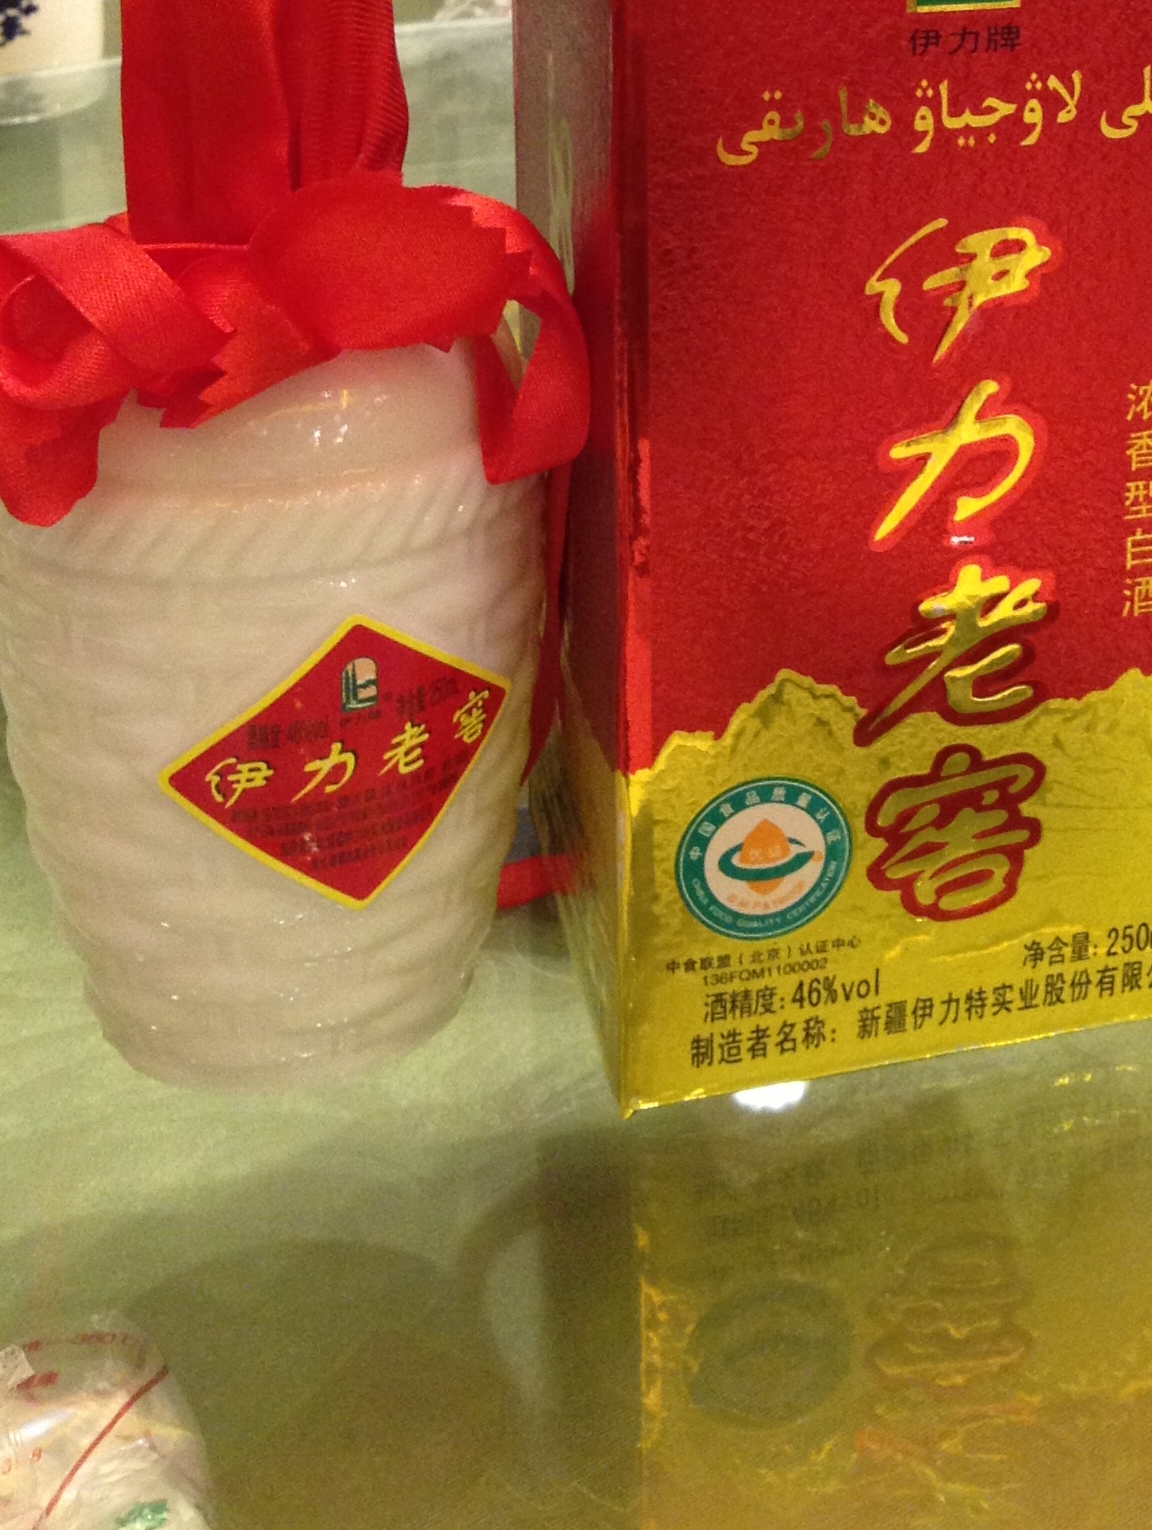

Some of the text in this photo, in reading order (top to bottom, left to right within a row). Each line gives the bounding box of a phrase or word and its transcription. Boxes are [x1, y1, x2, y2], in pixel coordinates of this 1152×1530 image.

[908, 22, 1022, 58] 伊力牌
[860, 216, 1054, 918] 伊力老窖
[204, 688, 490, 810] 伊力老窖
